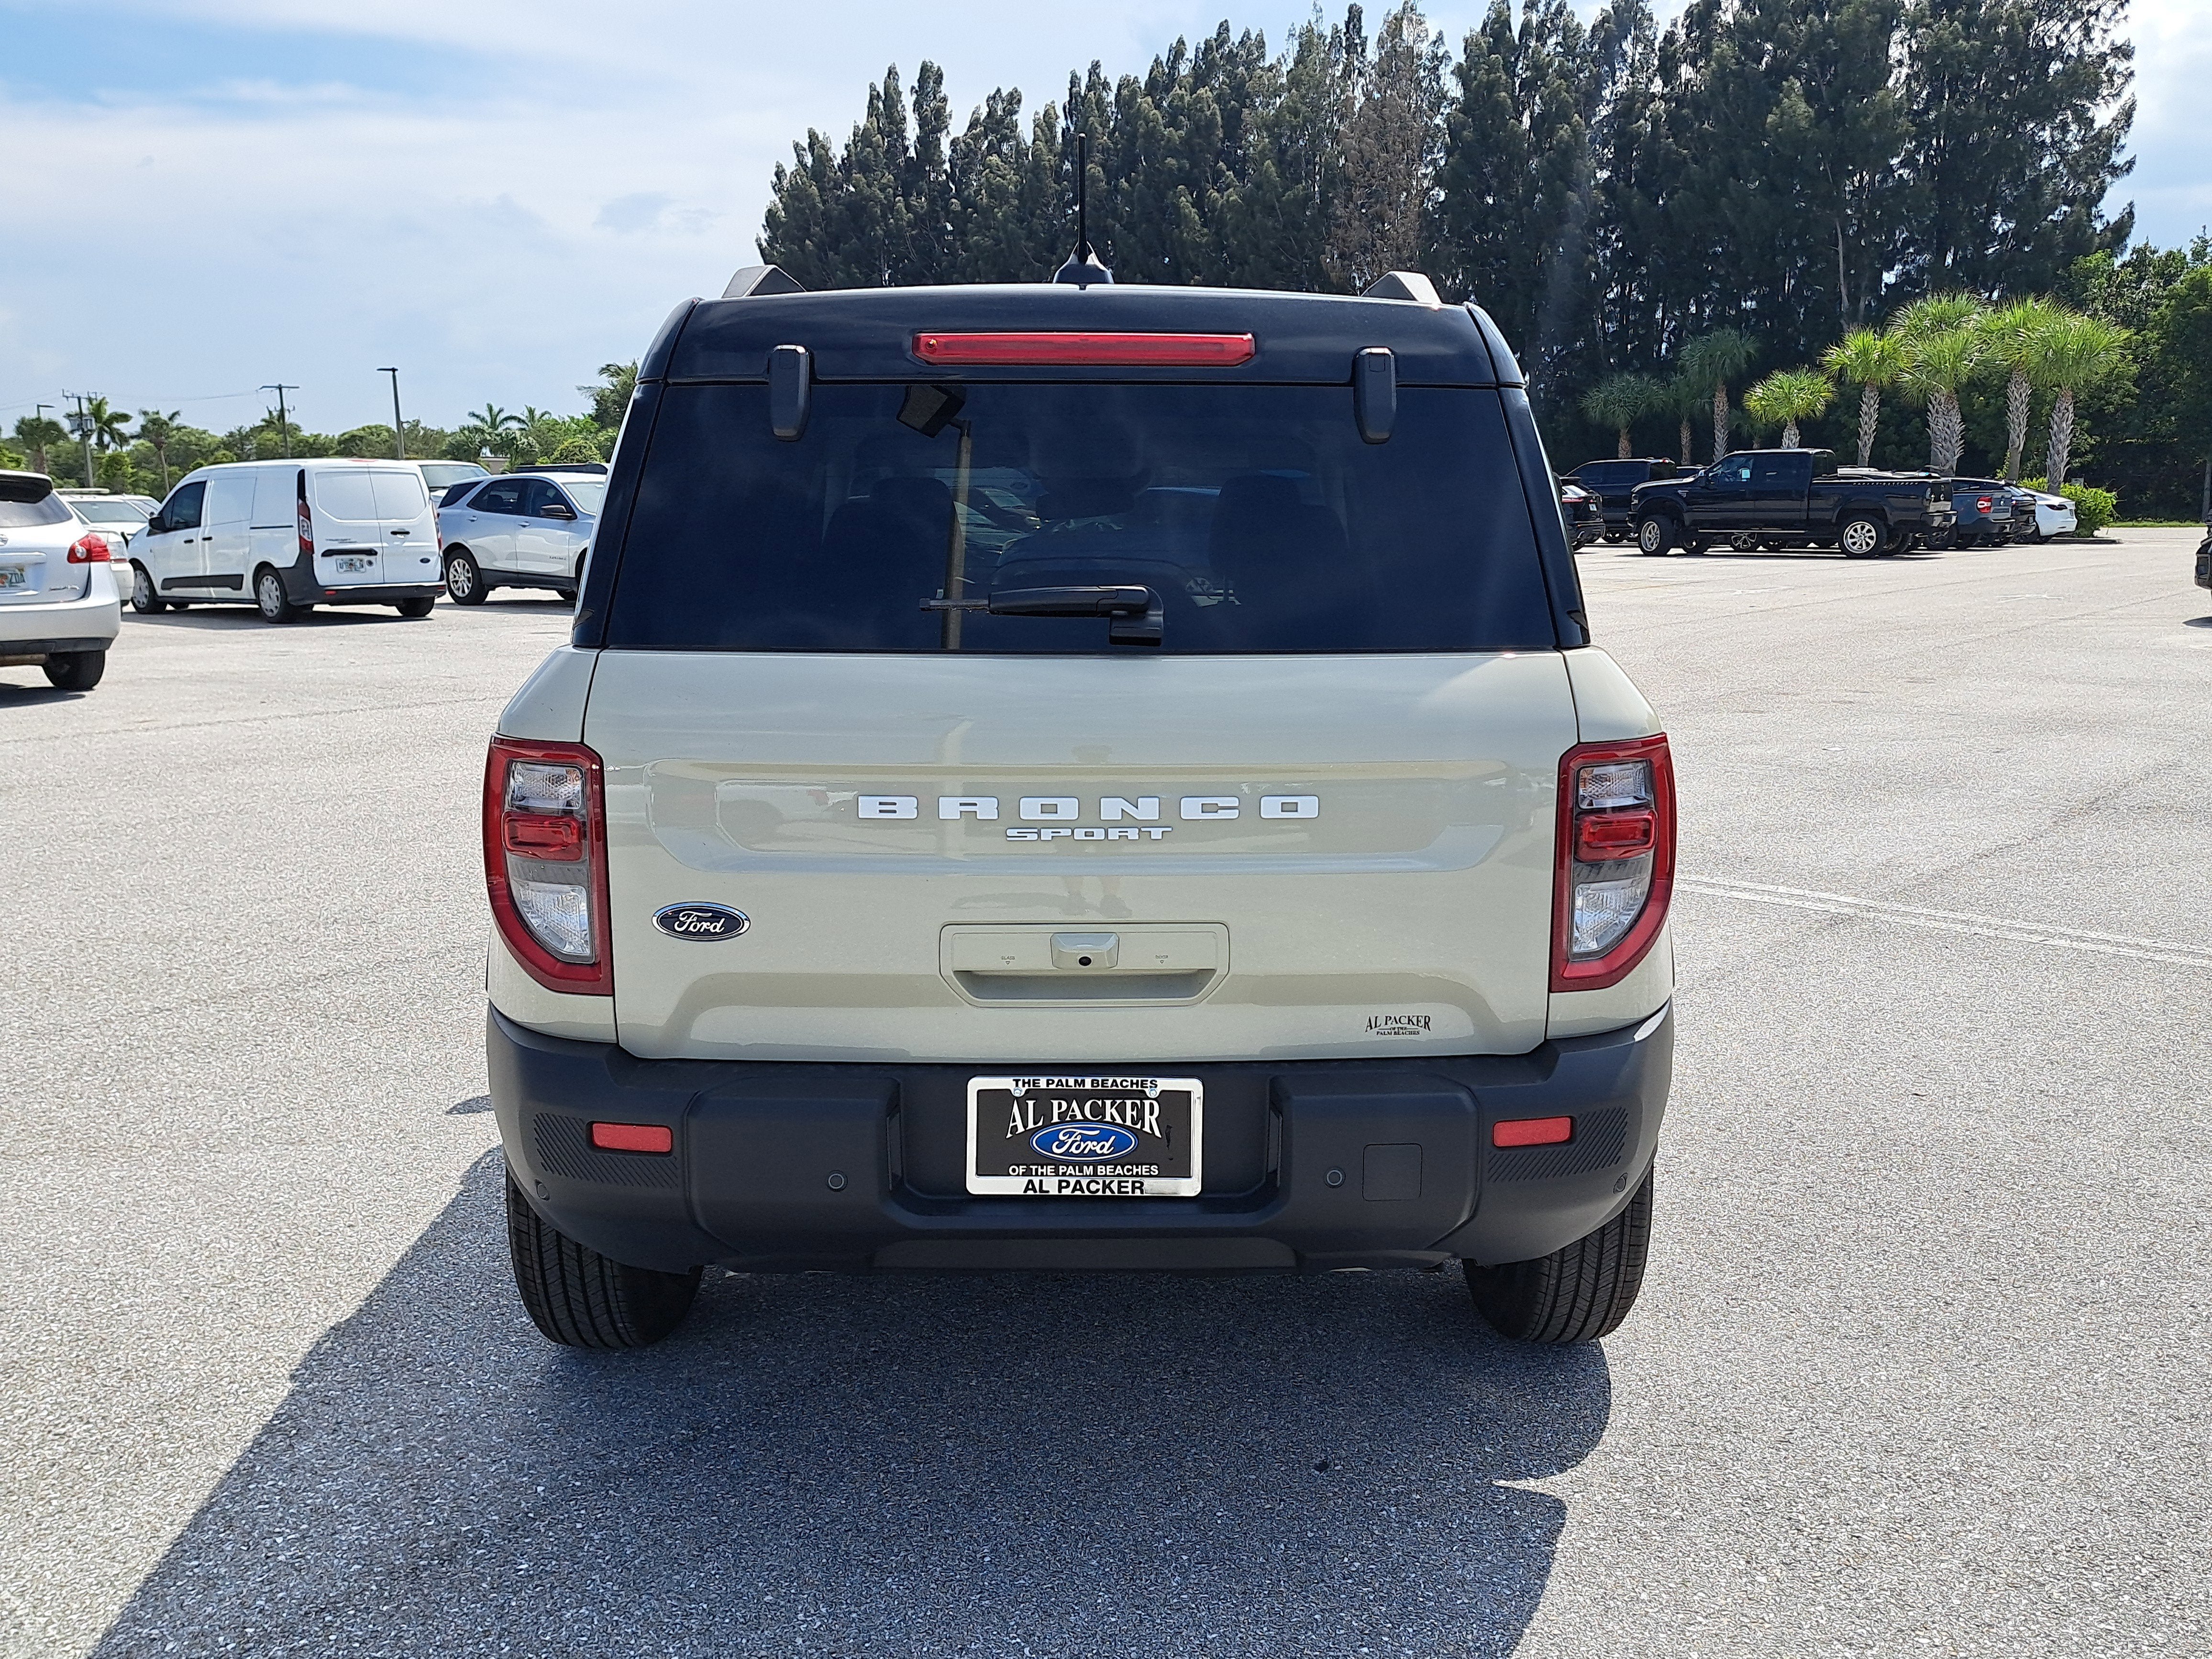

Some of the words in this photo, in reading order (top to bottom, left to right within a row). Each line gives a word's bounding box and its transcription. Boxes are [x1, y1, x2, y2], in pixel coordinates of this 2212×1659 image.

[857, 795, 1319, 820] BRONCO
[1006, 827, 1172, 841] SPORT
[674, 910, 725, 933] Ford
[1365, 1016, 1382, 1032] AL
[1384, 1015, 1431, 1032] PACKER
[1013, 1079, 1040, 1088] THE
[1046, 1079, 1085, 1088] PALM
[1091, 1079, 1158, 1088] BEACHES
[1006, 1099, 1044, 1139] AL
[1051, 1099, 1162, 1139] PACKER
[1052, 1128, 1116, 1154] Ford
[1009, 1165, 1028, 1175] OF
[1030, 1165, 1055, 1175] THE
[1059, 1165, 1093, 1175] PALM
[1097, 1165, 1159, 1175] BEACHES
[1023, 1179, 1050, 1194] AL
[1058, 1179, 1145, 1194] PACKER
